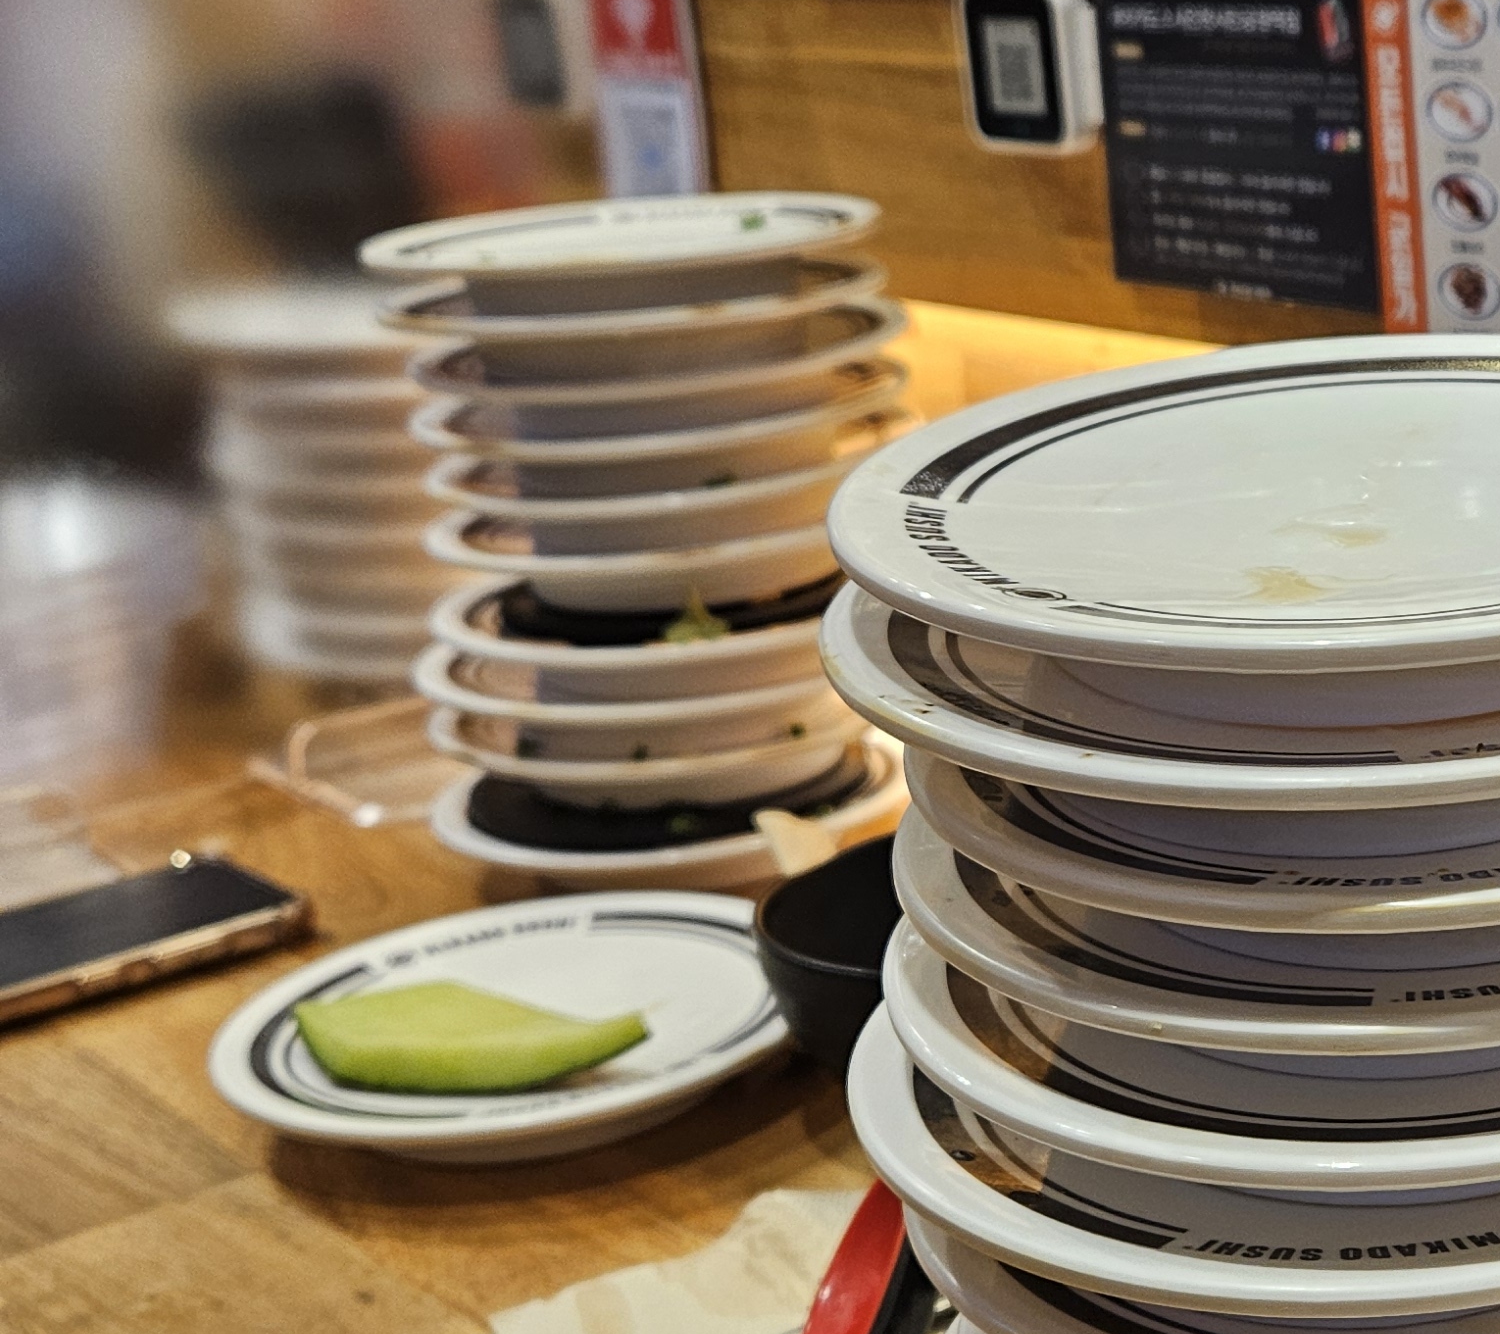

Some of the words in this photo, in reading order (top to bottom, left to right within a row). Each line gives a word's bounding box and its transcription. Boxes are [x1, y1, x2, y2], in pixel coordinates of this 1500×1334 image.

[903, 502, 951, 543] SUSHI
[918, 543, 1016, 590] MIKADO
[1199, 1239, 1323, 1262] SUSHI
